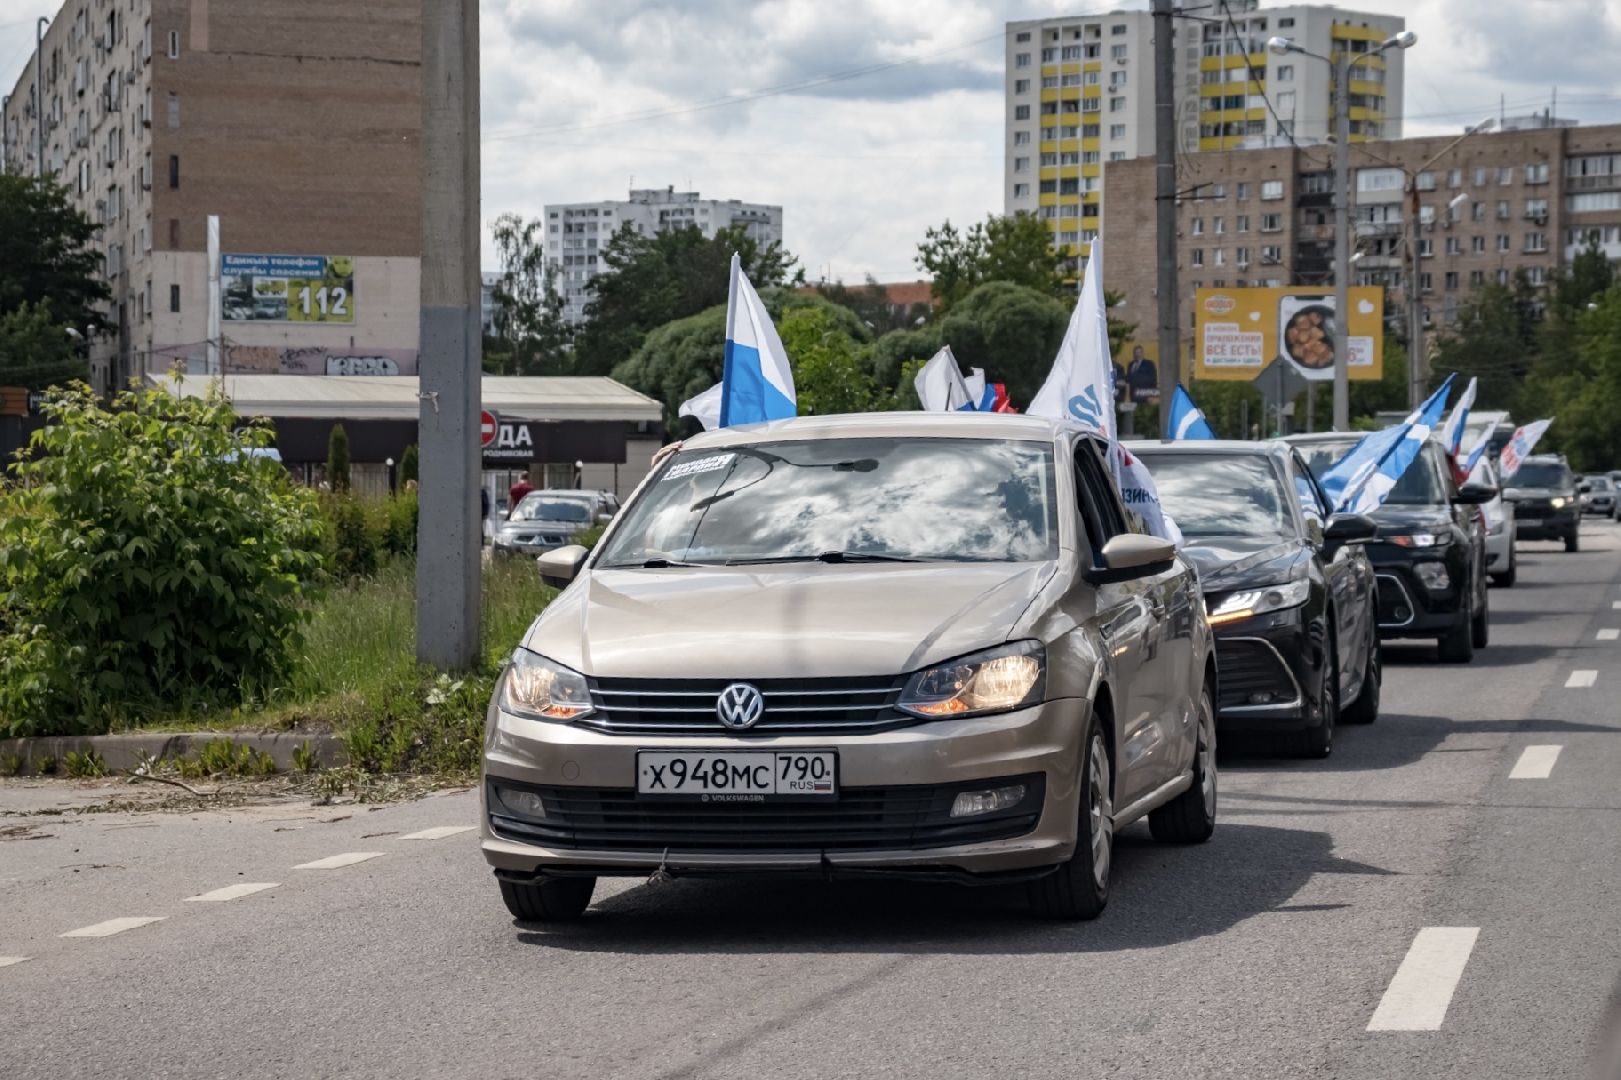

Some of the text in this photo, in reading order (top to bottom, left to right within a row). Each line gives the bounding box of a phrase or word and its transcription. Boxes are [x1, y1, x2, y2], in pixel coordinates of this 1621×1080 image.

[225, 255, 319, 267] Единый телефон
[222, 267, 320, 276] службы спасения
[298, 286, 346, 315] 112
[778, 756, 825, 780] 790
[789, 781, 814, 790] RUS
